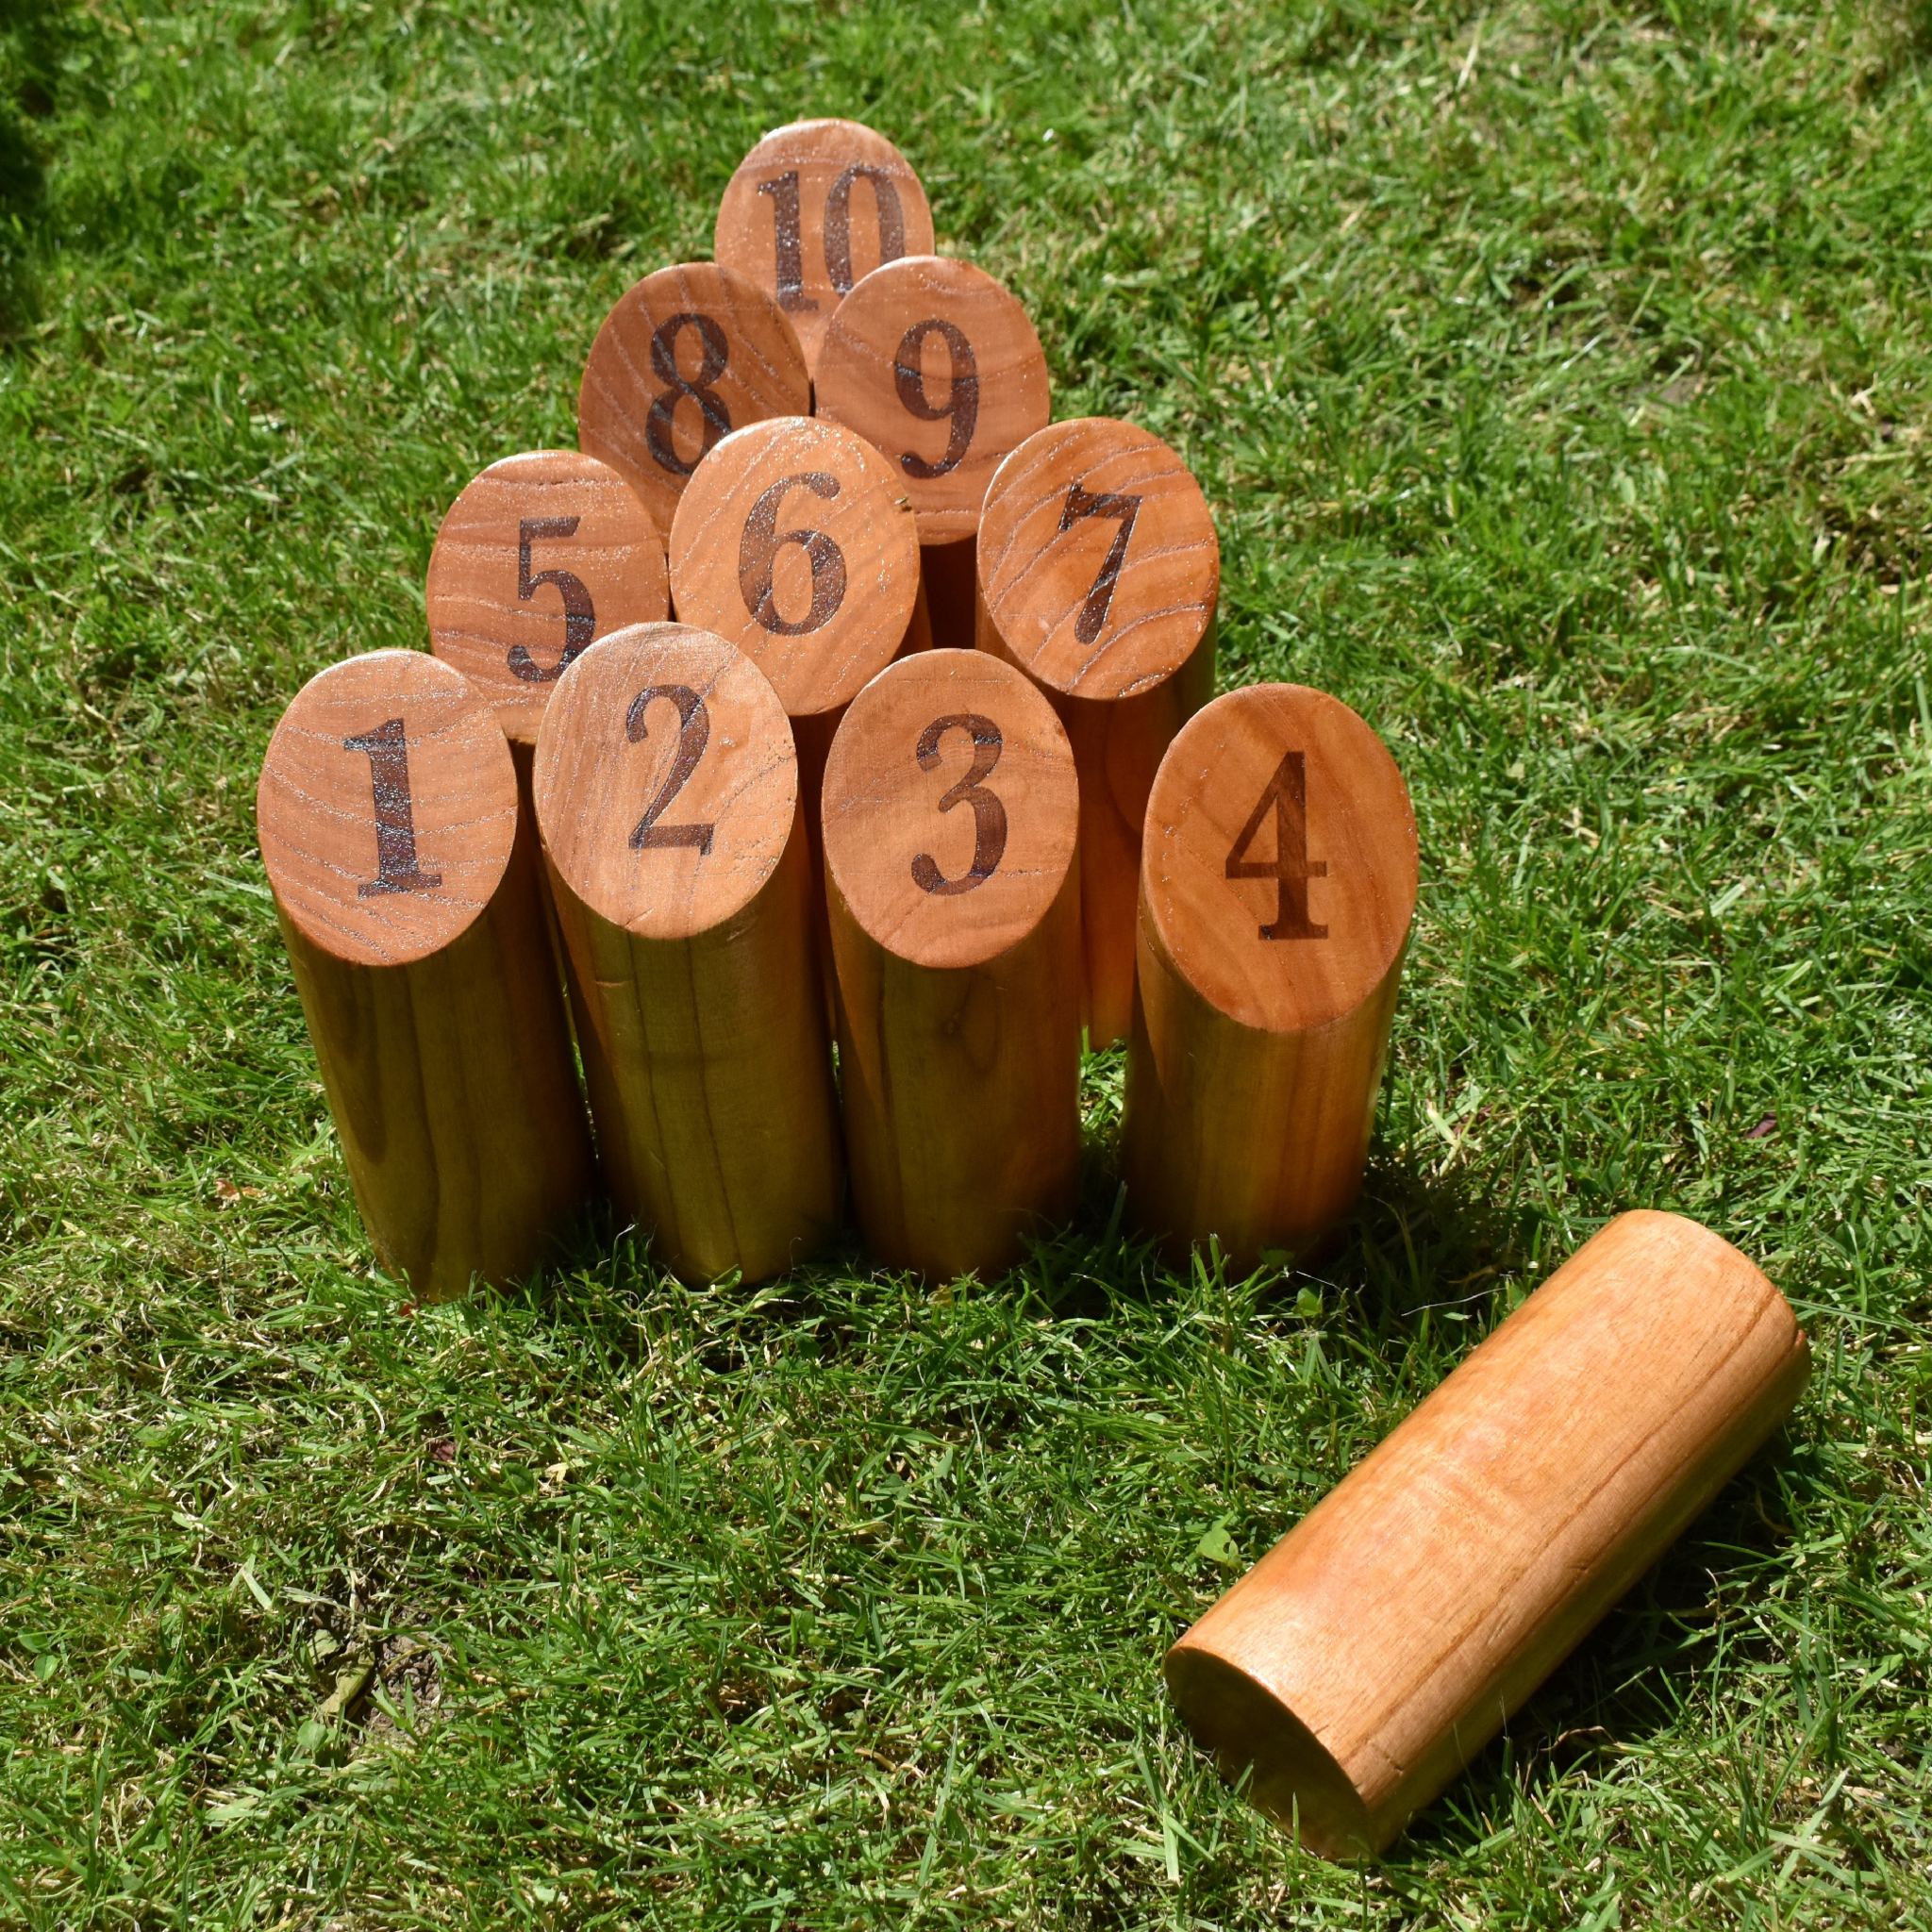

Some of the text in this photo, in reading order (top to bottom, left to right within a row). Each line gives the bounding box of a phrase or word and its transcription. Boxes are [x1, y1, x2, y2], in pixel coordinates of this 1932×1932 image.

[758, 164, 906, 311] 10
[645, 312, 732, 473] 8
[893, 319, 979, 479] 9
[507, 516, 596, 683] 5
[739, 472, 848, 635] 6
[1058, 483, 1141, 645] 7
[343, 718, 442, 898] 1
[625, 684, 715, 856] 2
[910, 713, 1008, 897] 3
[1225, 751, 1329, 941] 4
